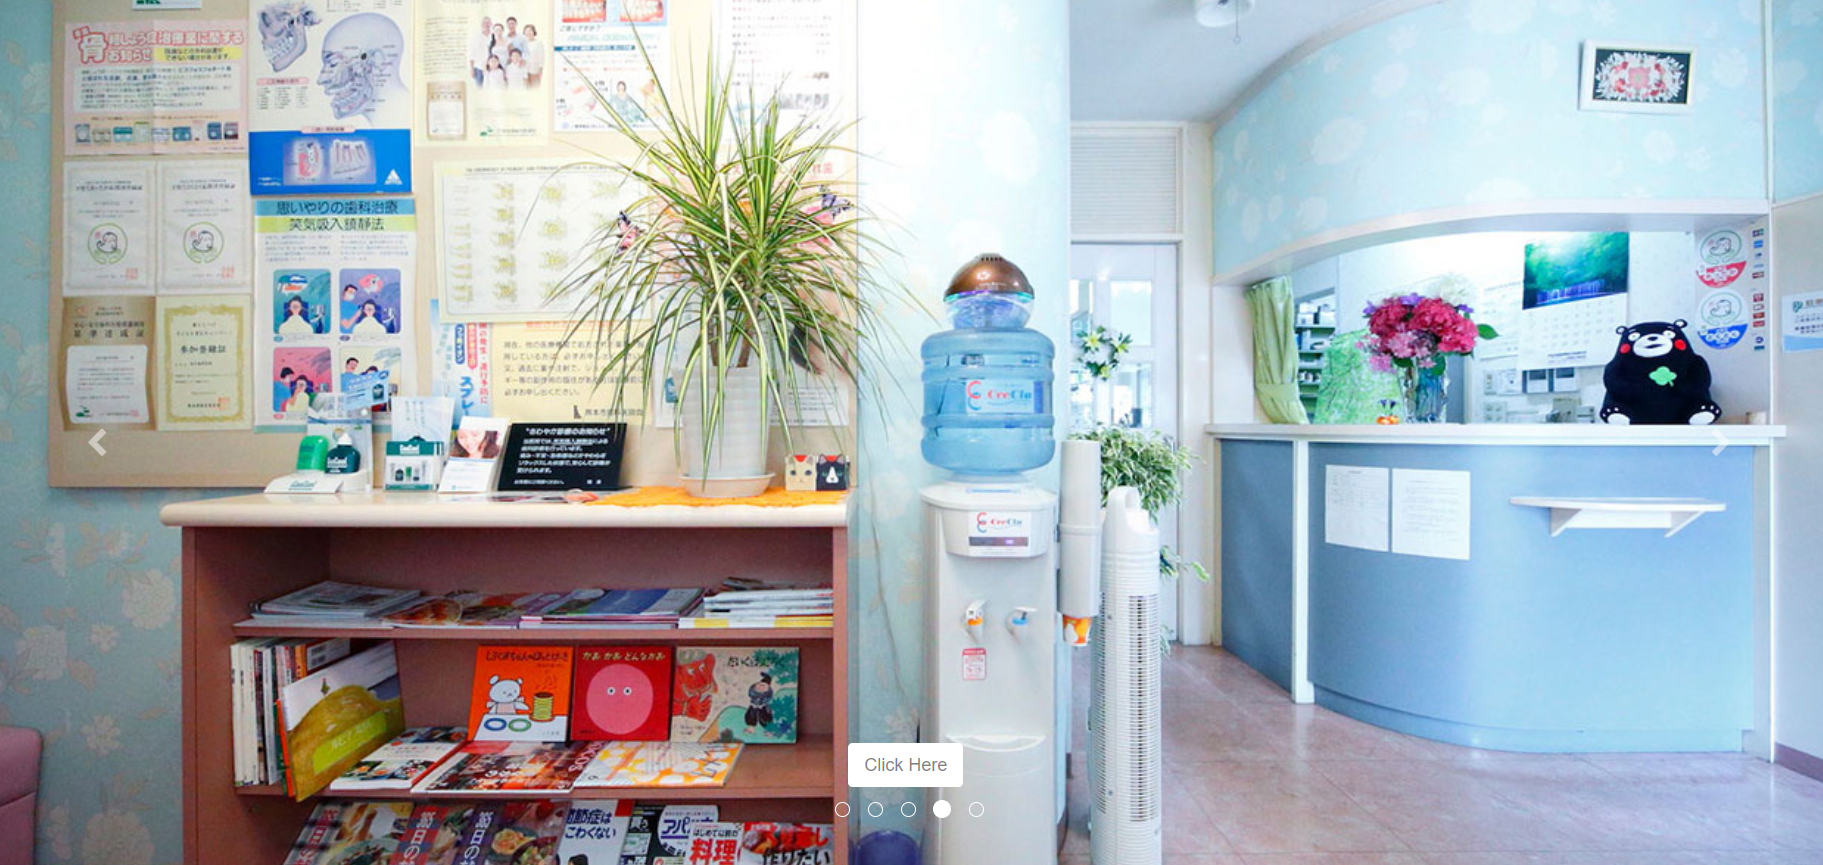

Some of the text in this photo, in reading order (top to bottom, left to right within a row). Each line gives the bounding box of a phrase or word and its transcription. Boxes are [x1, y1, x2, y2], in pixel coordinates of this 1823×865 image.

[276, 200, 398, 215] 思いやりの歯科治療
[289, 217, 384, 232] 笑気吸入鎮静法
[582, 651, 666, 662] かお かお どんなかお
[565, 826, 617, 840] こわくない
[689, 837, 738, 865] 料理
